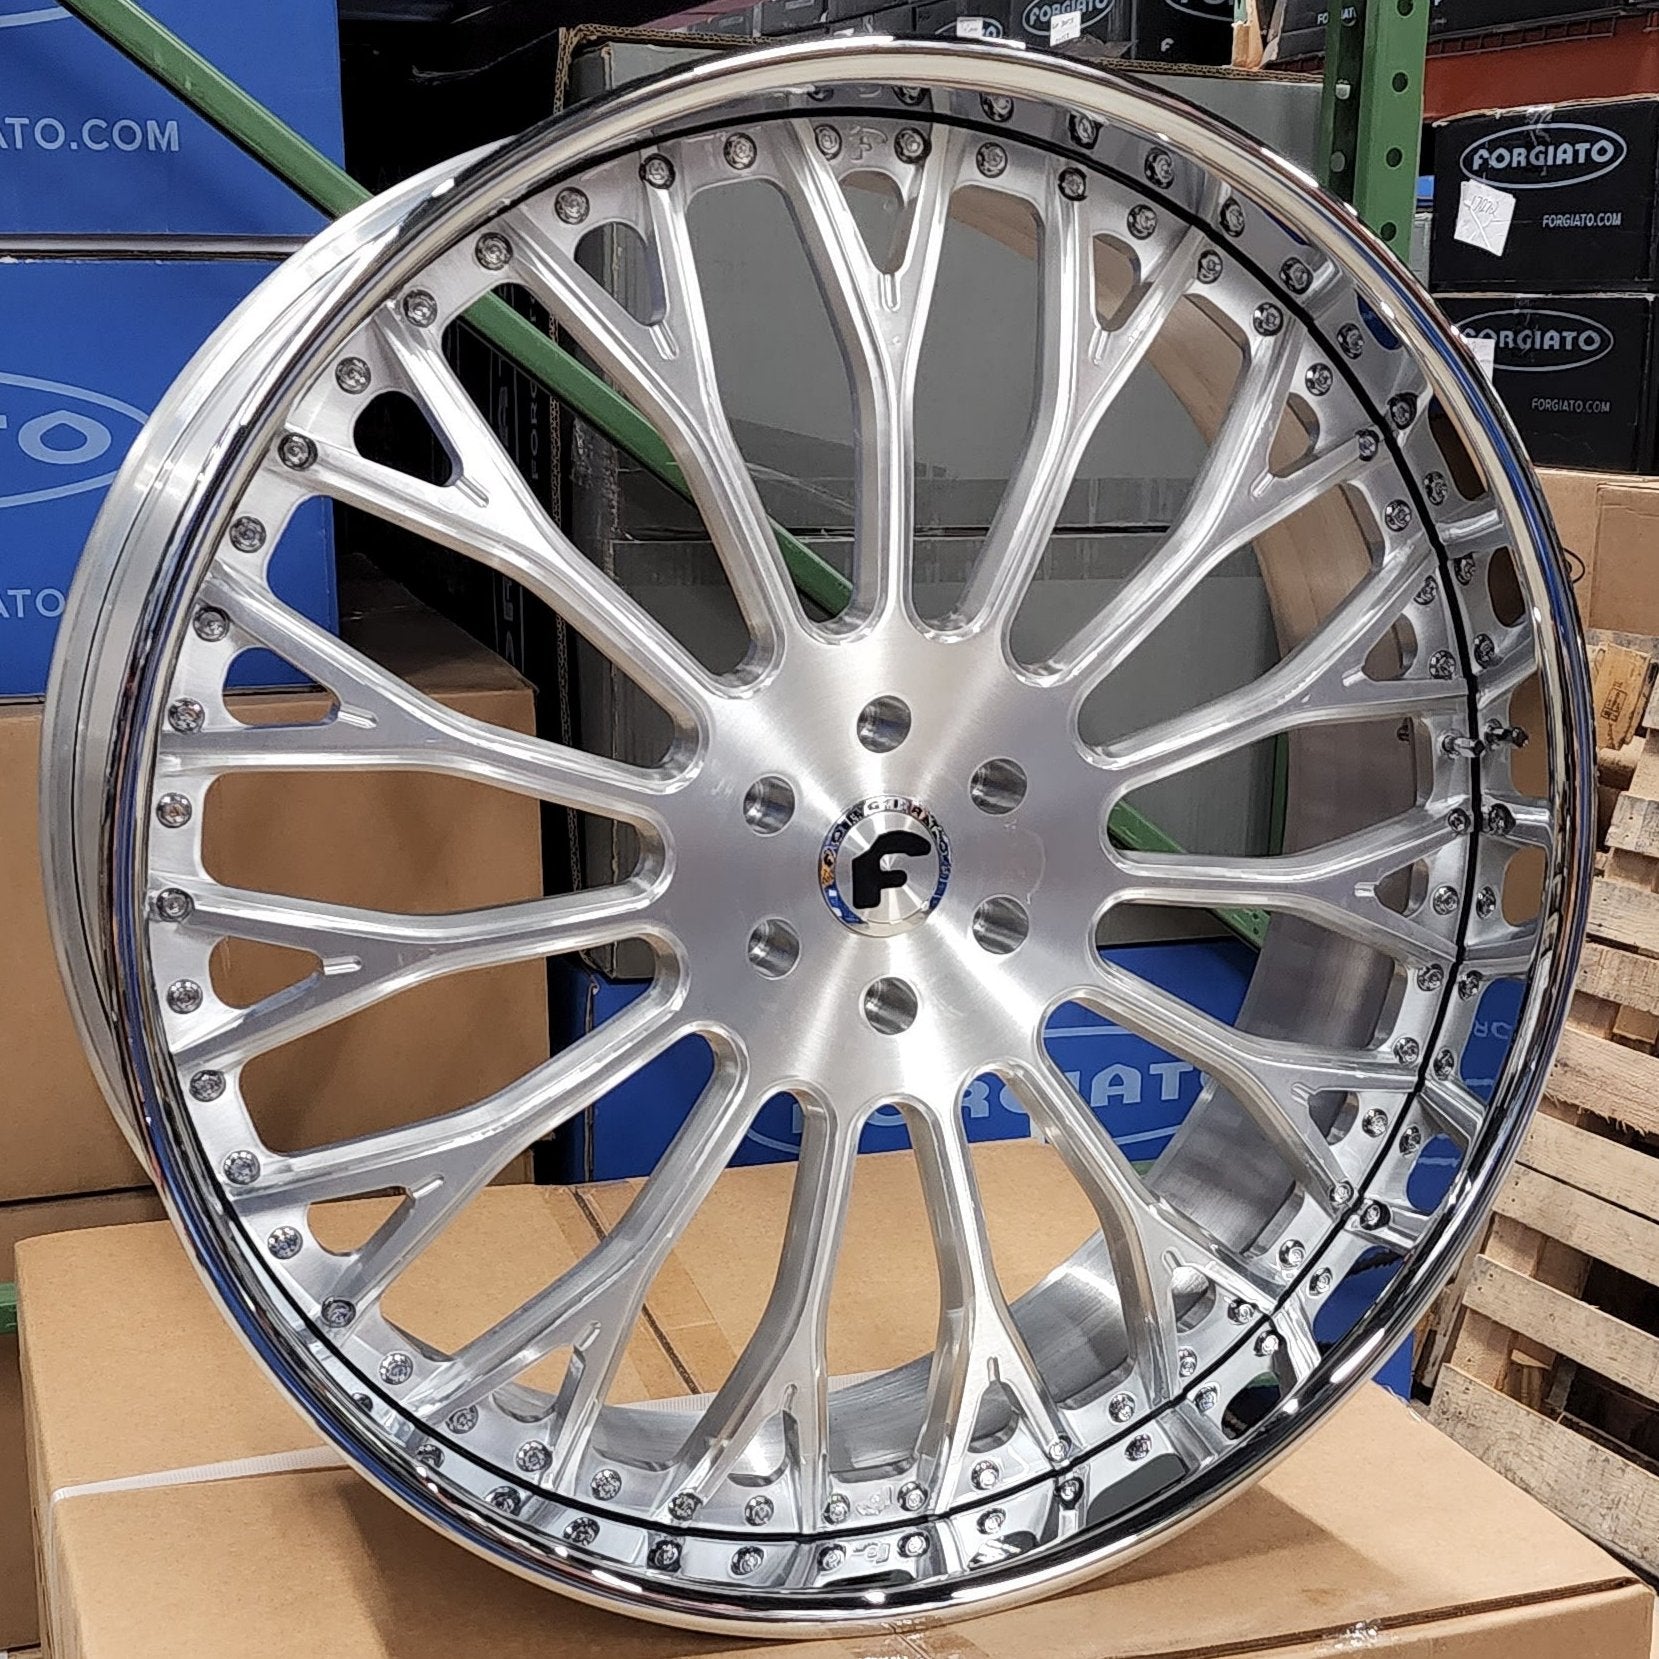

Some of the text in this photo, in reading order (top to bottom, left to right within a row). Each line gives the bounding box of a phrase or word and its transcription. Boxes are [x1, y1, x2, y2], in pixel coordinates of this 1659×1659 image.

[0, 117, 180, 151] TO.COM
[1472, 139, 1615, 171] FORGIATO
[1542, 212, 1622, 228] FORGIATO.COM
[1531, 397, 1611, 413] FORGIATO.COM
[0, 588, 65, 619] TO
[851, 829, 932, 910] F
